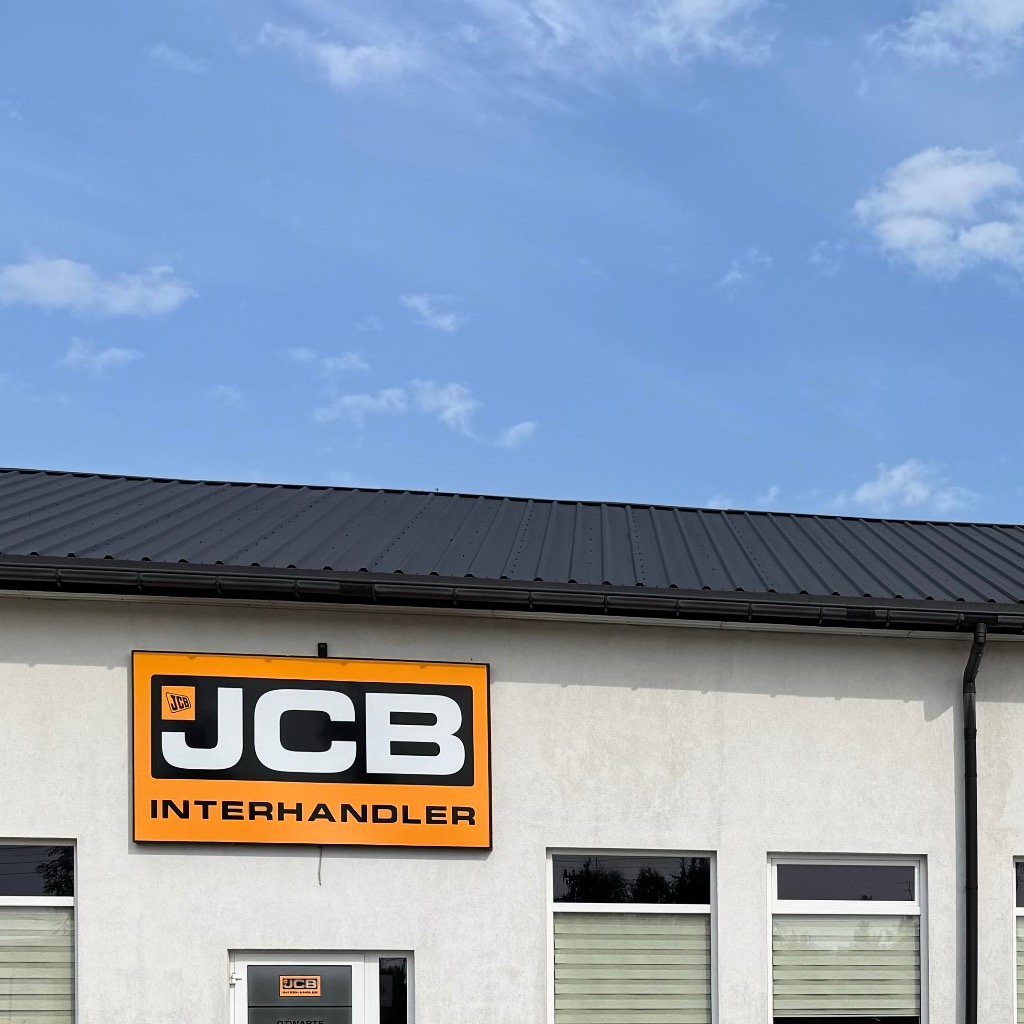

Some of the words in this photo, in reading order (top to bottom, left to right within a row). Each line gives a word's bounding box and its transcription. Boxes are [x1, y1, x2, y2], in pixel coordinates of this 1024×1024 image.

[170, 695, 190, 711] JCB
[161, 686, 466, 776] JCB
[150, 799, 476, 826] INTERHANDLER
[283, 979, 317, 989] JCB
